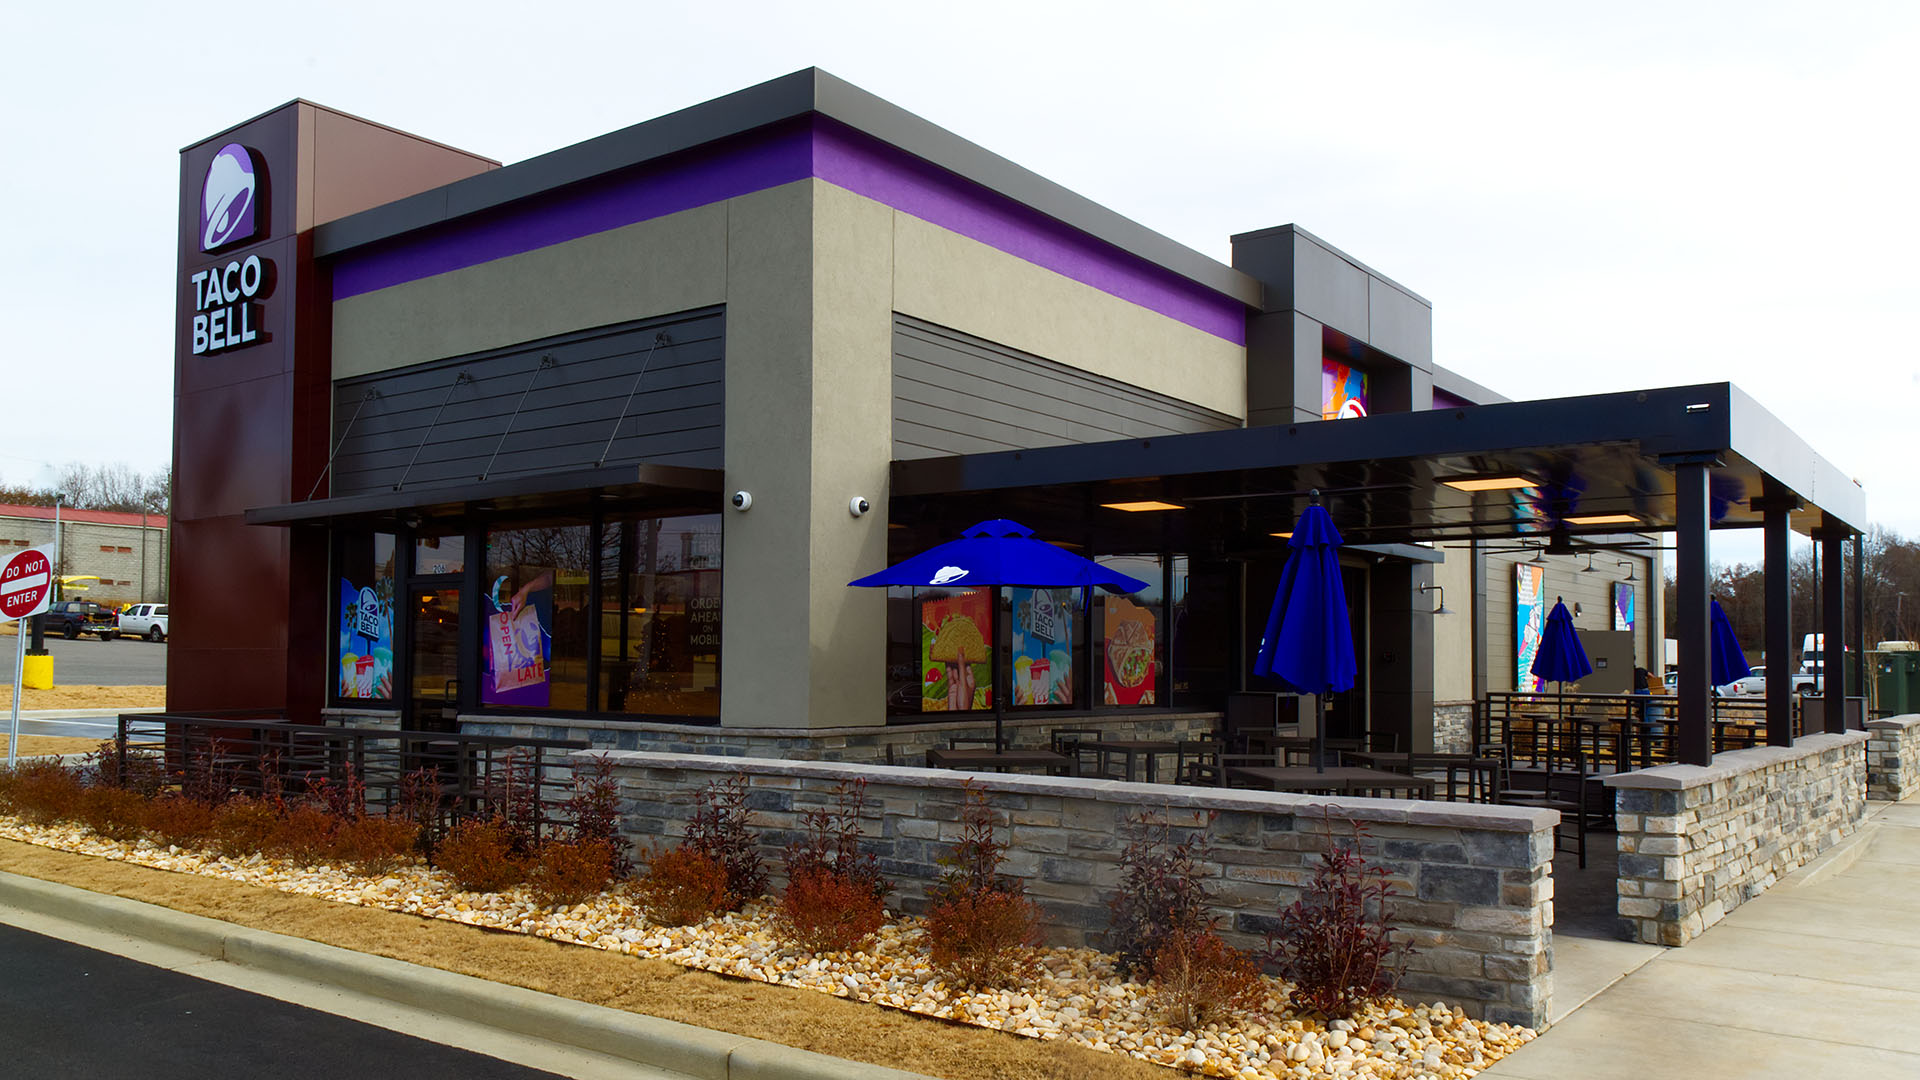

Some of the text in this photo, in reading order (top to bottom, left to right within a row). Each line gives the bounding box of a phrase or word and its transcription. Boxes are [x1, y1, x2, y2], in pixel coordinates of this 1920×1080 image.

[192, 254, 261, 312] TACO
[193, 302, 256, 354] BELL
[691, 523, 721, 537] DRIV
[6, 559, 44, 579] DO NOT
[7, 590, 37, 608] ENTER
[691, 598, 721, 609] ORDE
[360, 610, 379, 627] TACO
[690, 611, 721, 623] AHEA
[1034, 610, 1054, 628] TACO
[360, 621, 379, 636] BELL
[500, 611, 513, 656] OPEN
[702, 625, 713, 633] ON
[1035, 622, 1054, 639] BELL
[690, 634, 721, 646] MOBIL
[517, 662, 544, 683] LATE
